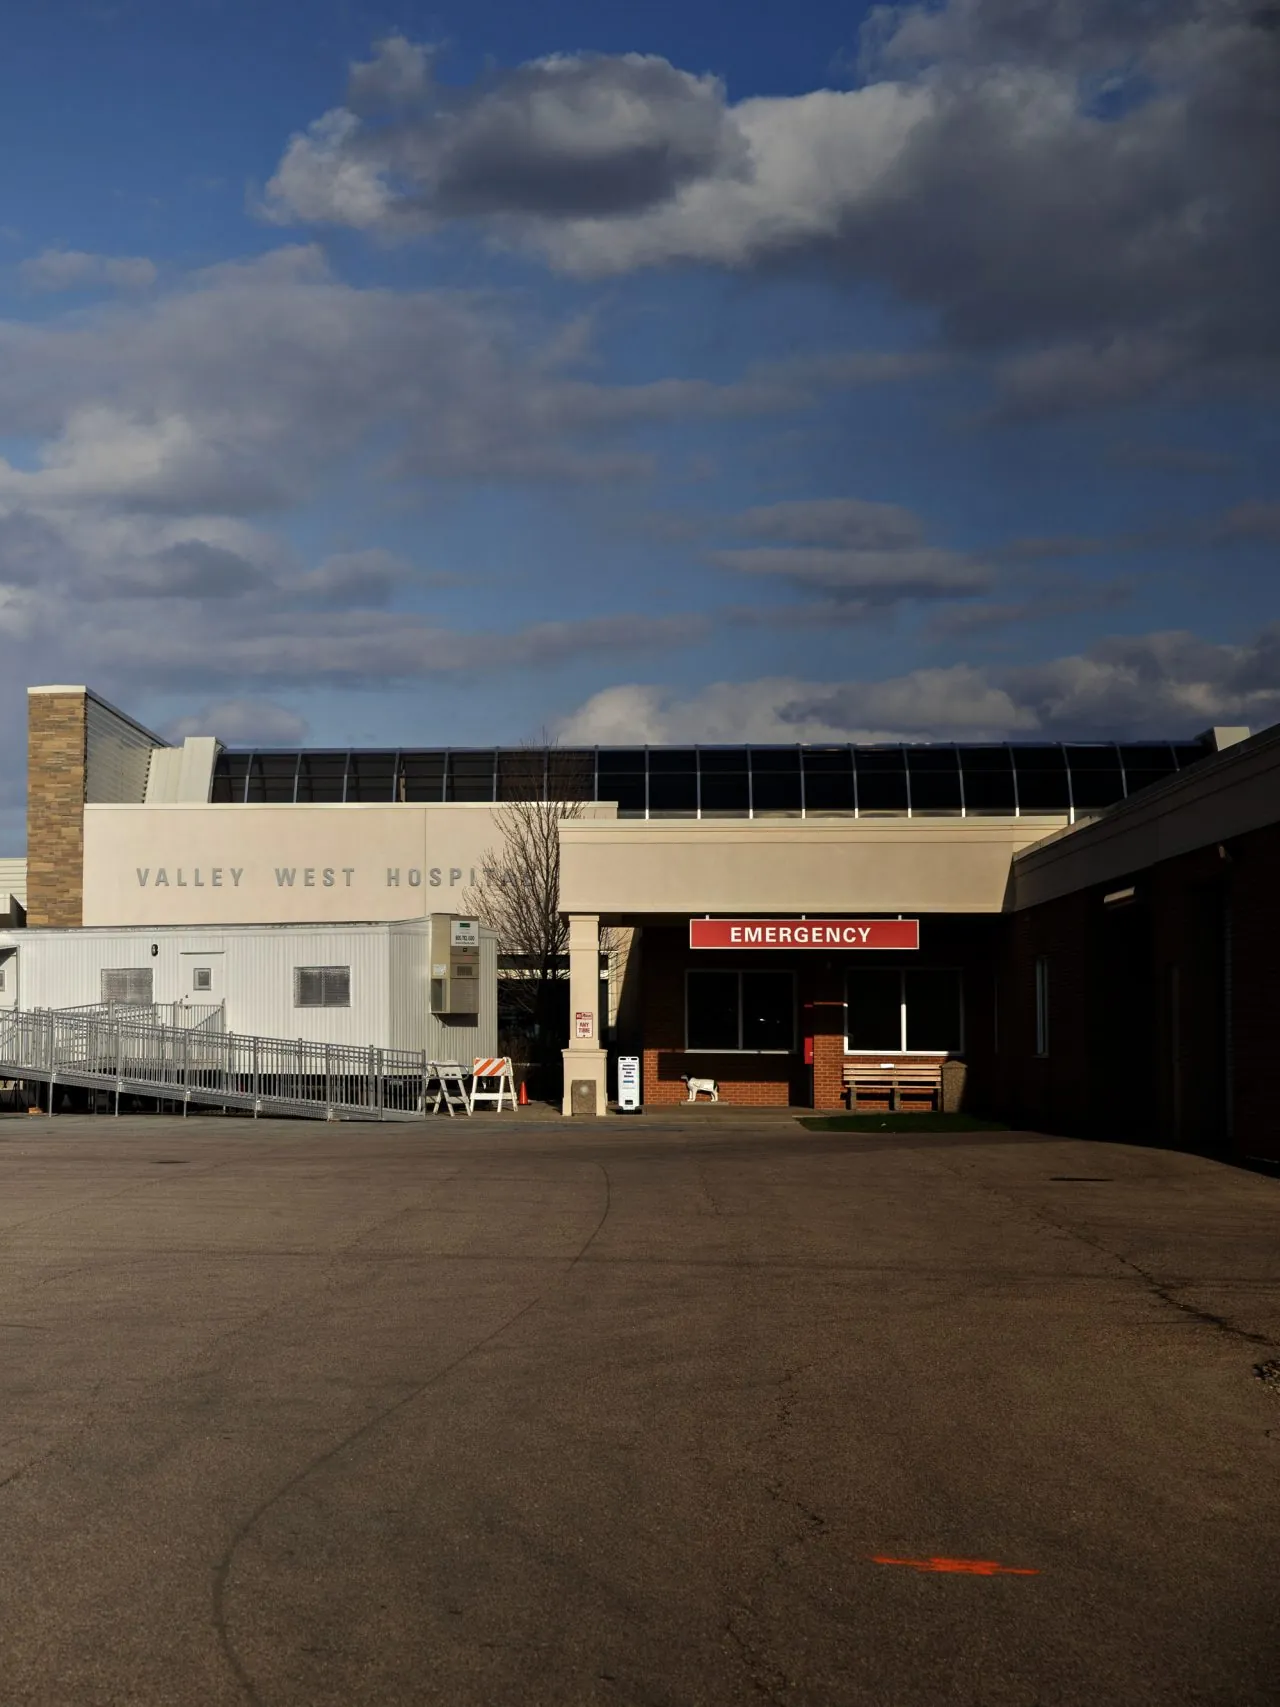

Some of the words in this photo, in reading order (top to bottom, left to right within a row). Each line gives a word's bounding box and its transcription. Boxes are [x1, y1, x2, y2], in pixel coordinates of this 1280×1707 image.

[136, 867, 245, 887] VALLEY
[275, 867, 355, 887] WEST
[730, 927, 871, 943] EMERGENCY
